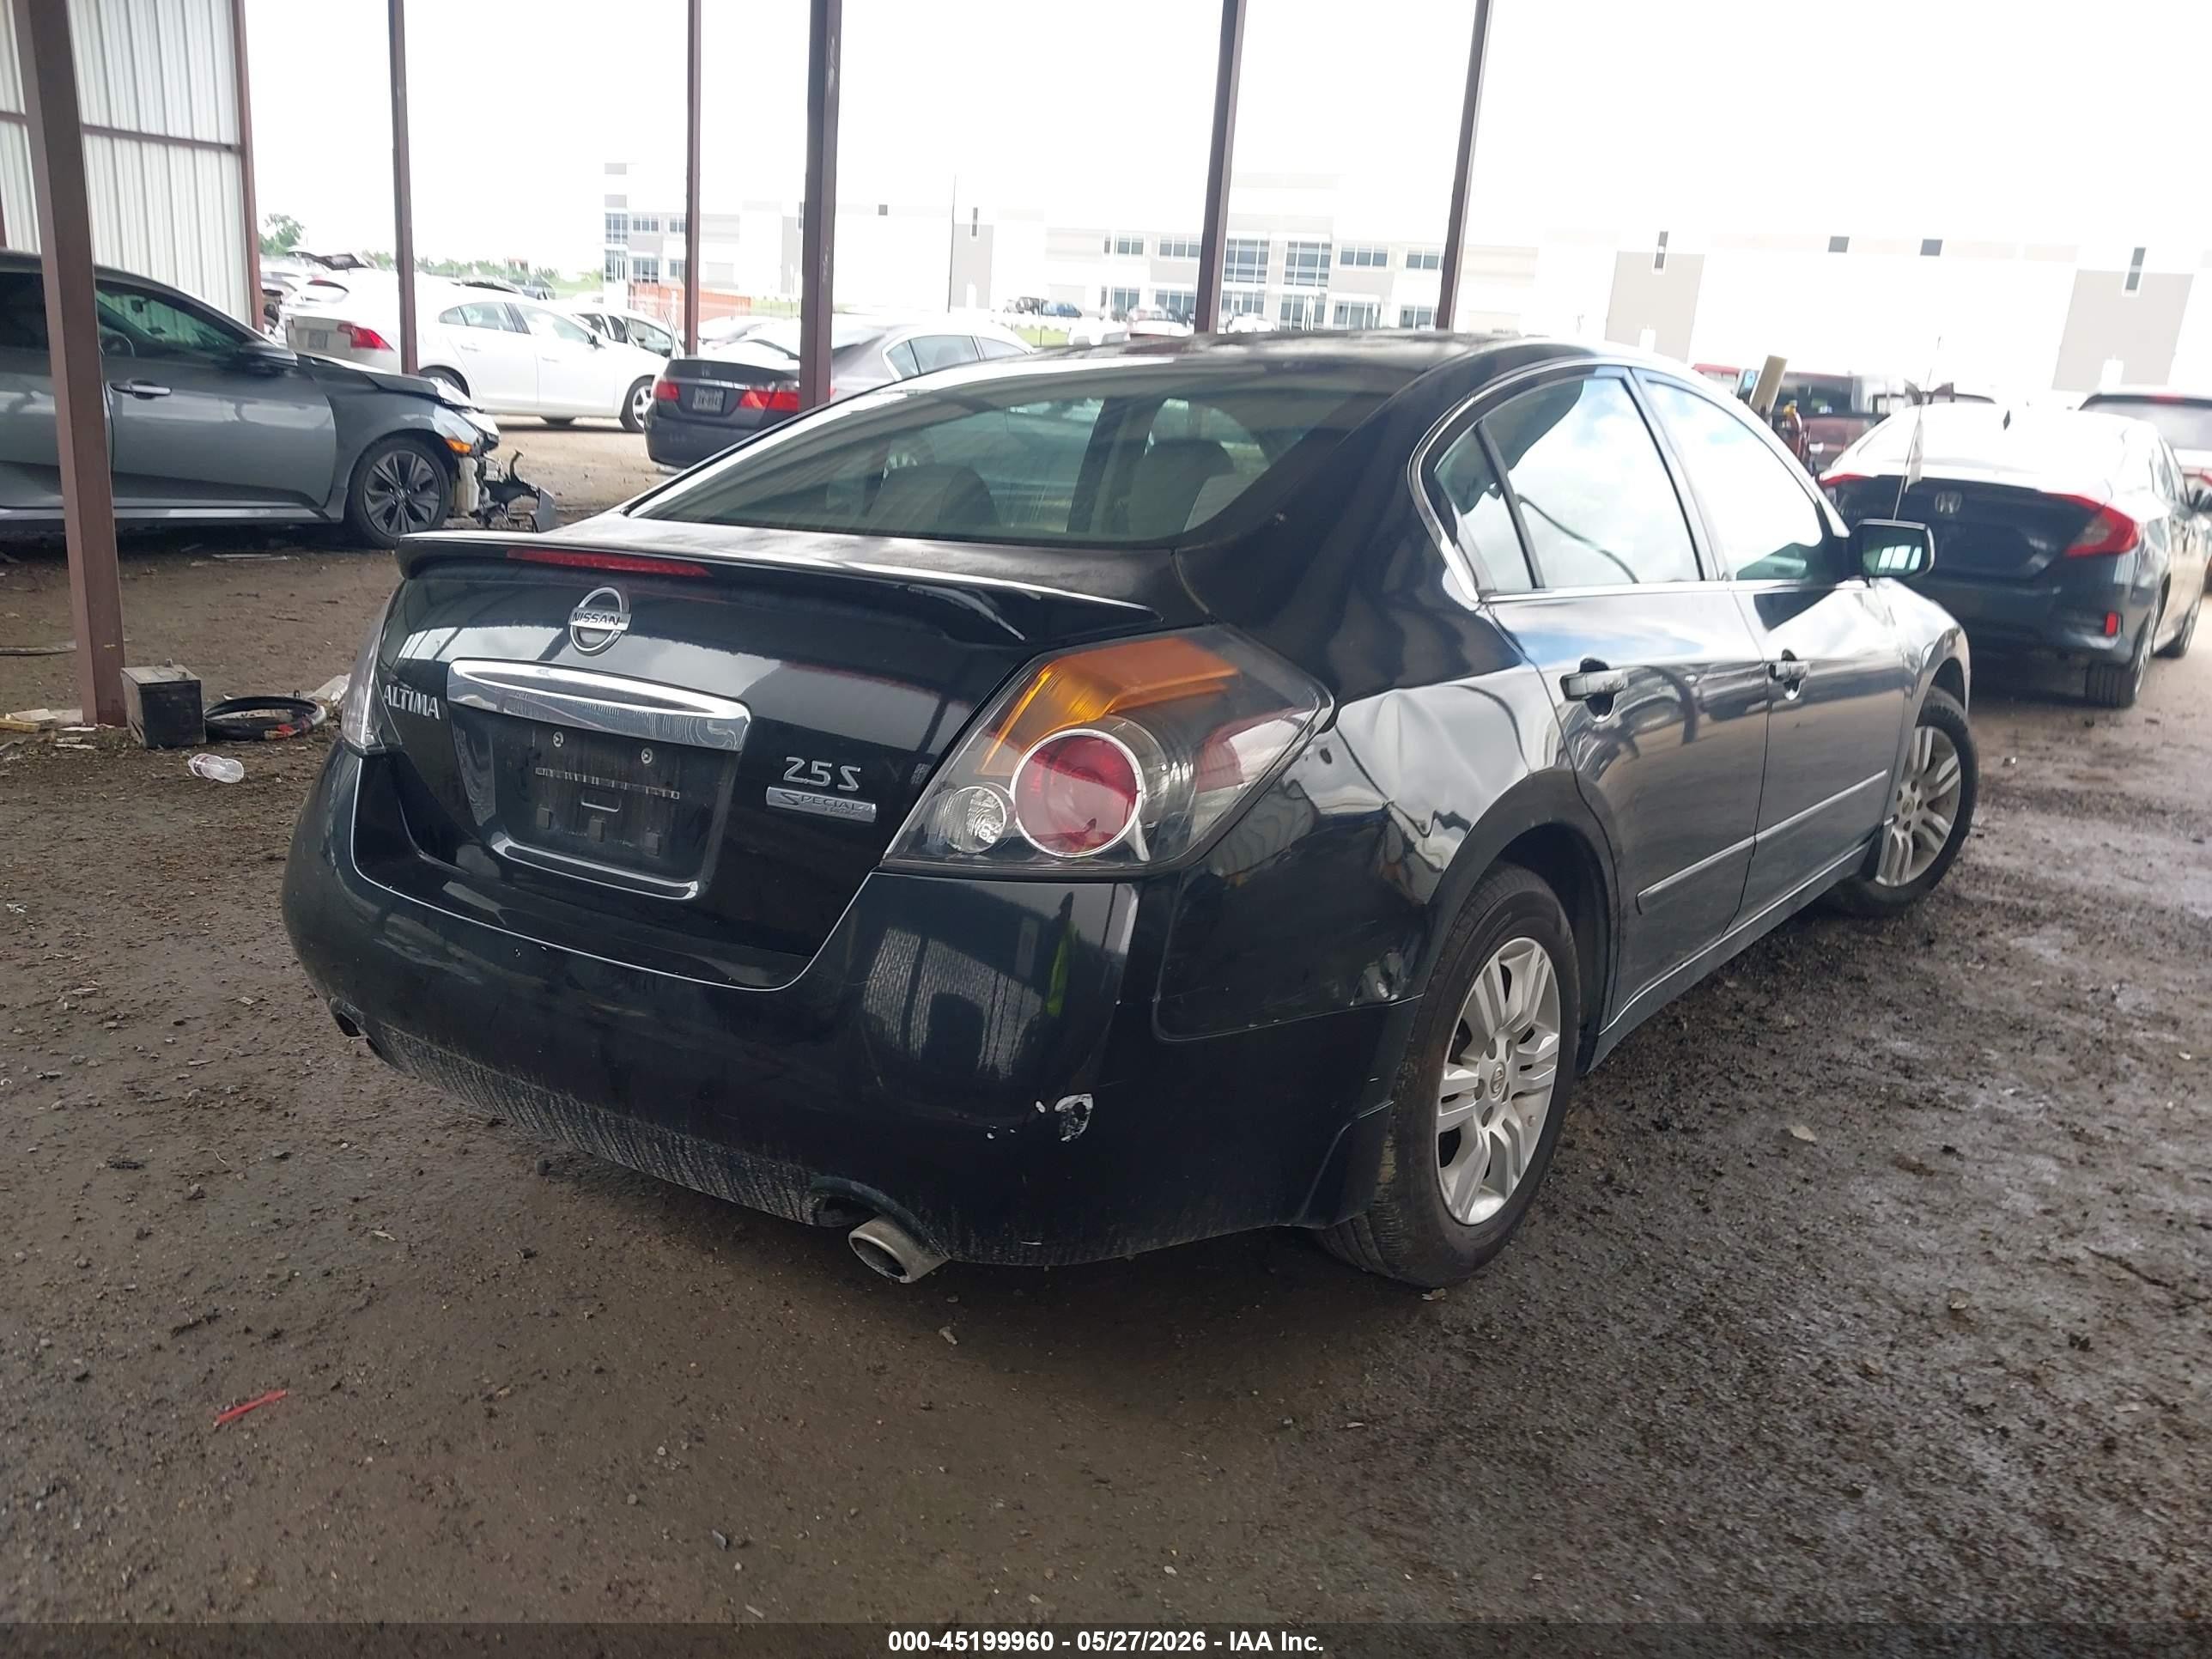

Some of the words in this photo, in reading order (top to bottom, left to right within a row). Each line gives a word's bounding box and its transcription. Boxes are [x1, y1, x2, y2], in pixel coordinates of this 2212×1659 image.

[572, 611, 621, 626] NISSAN
[383, 684, 440, 720] ALTIMA
[837, 765, 862, 792] S
